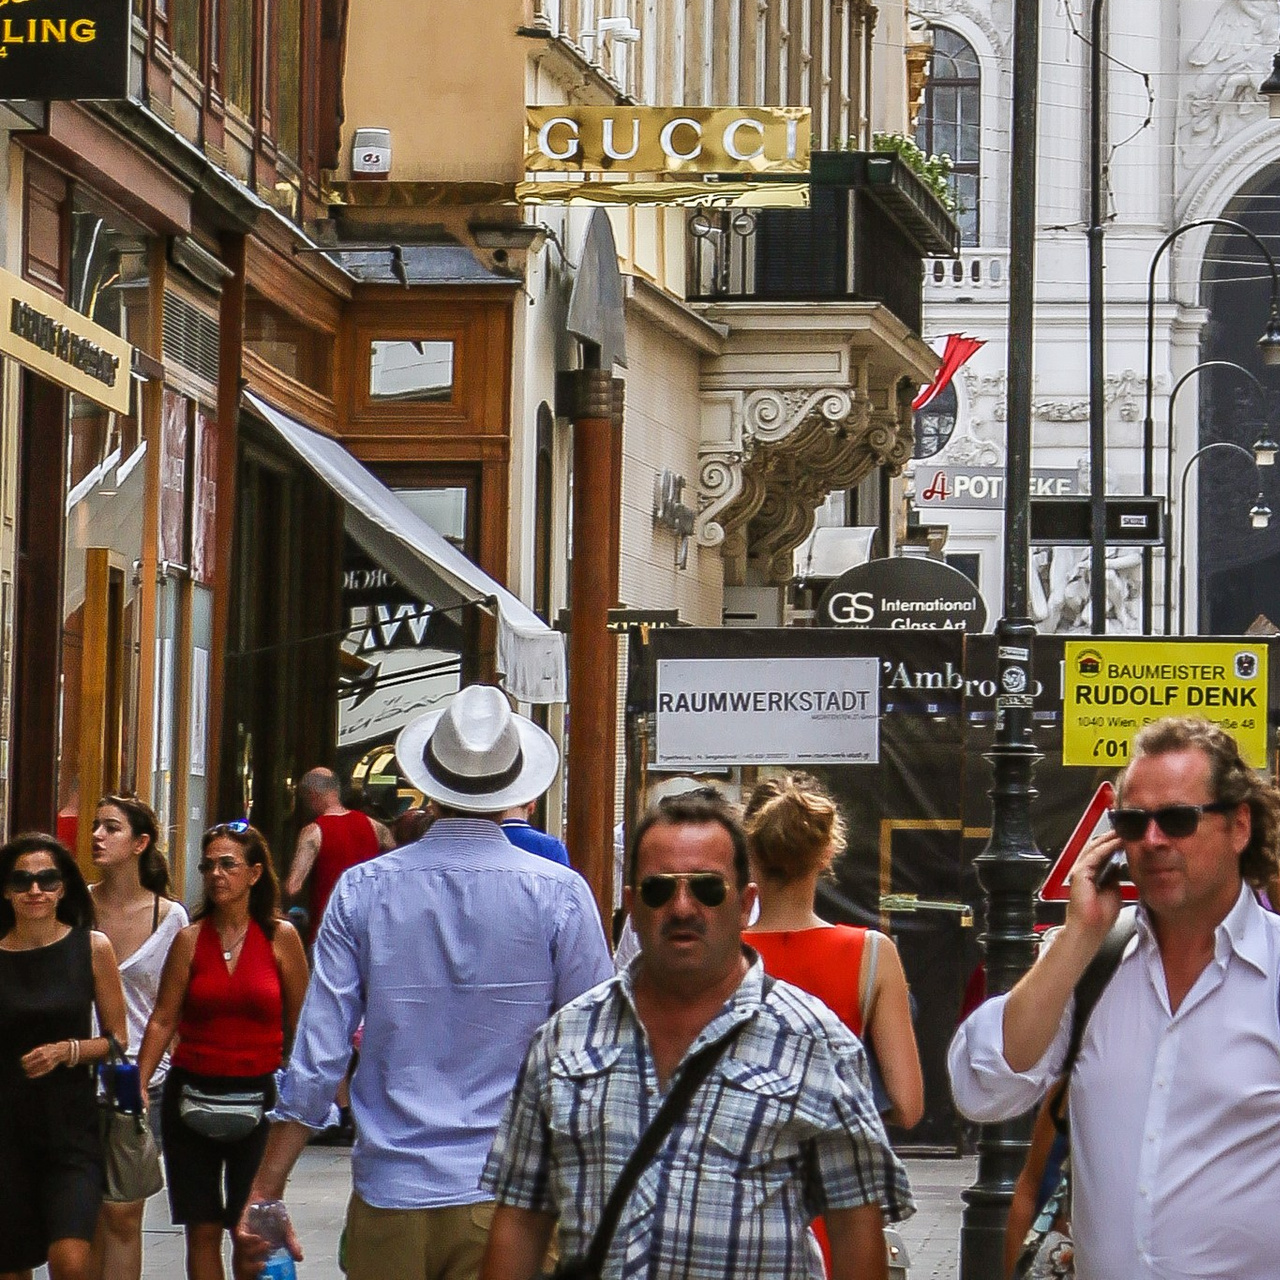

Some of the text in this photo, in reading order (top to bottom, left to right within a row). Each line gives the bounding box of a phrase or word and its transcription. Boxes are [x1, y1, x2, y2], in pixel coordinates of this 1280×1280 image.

[537, 116, 797, 160] GUCCI
[828, 592, 875, 623] GS
[881, 597, 977, 612] International
[1108, 664, 1225, 680] BAUMEISTER
[659, 691, 870, 713] RAUMWERKSTADT
[1076, 685, 1258, 707] RUDOLF DENK
